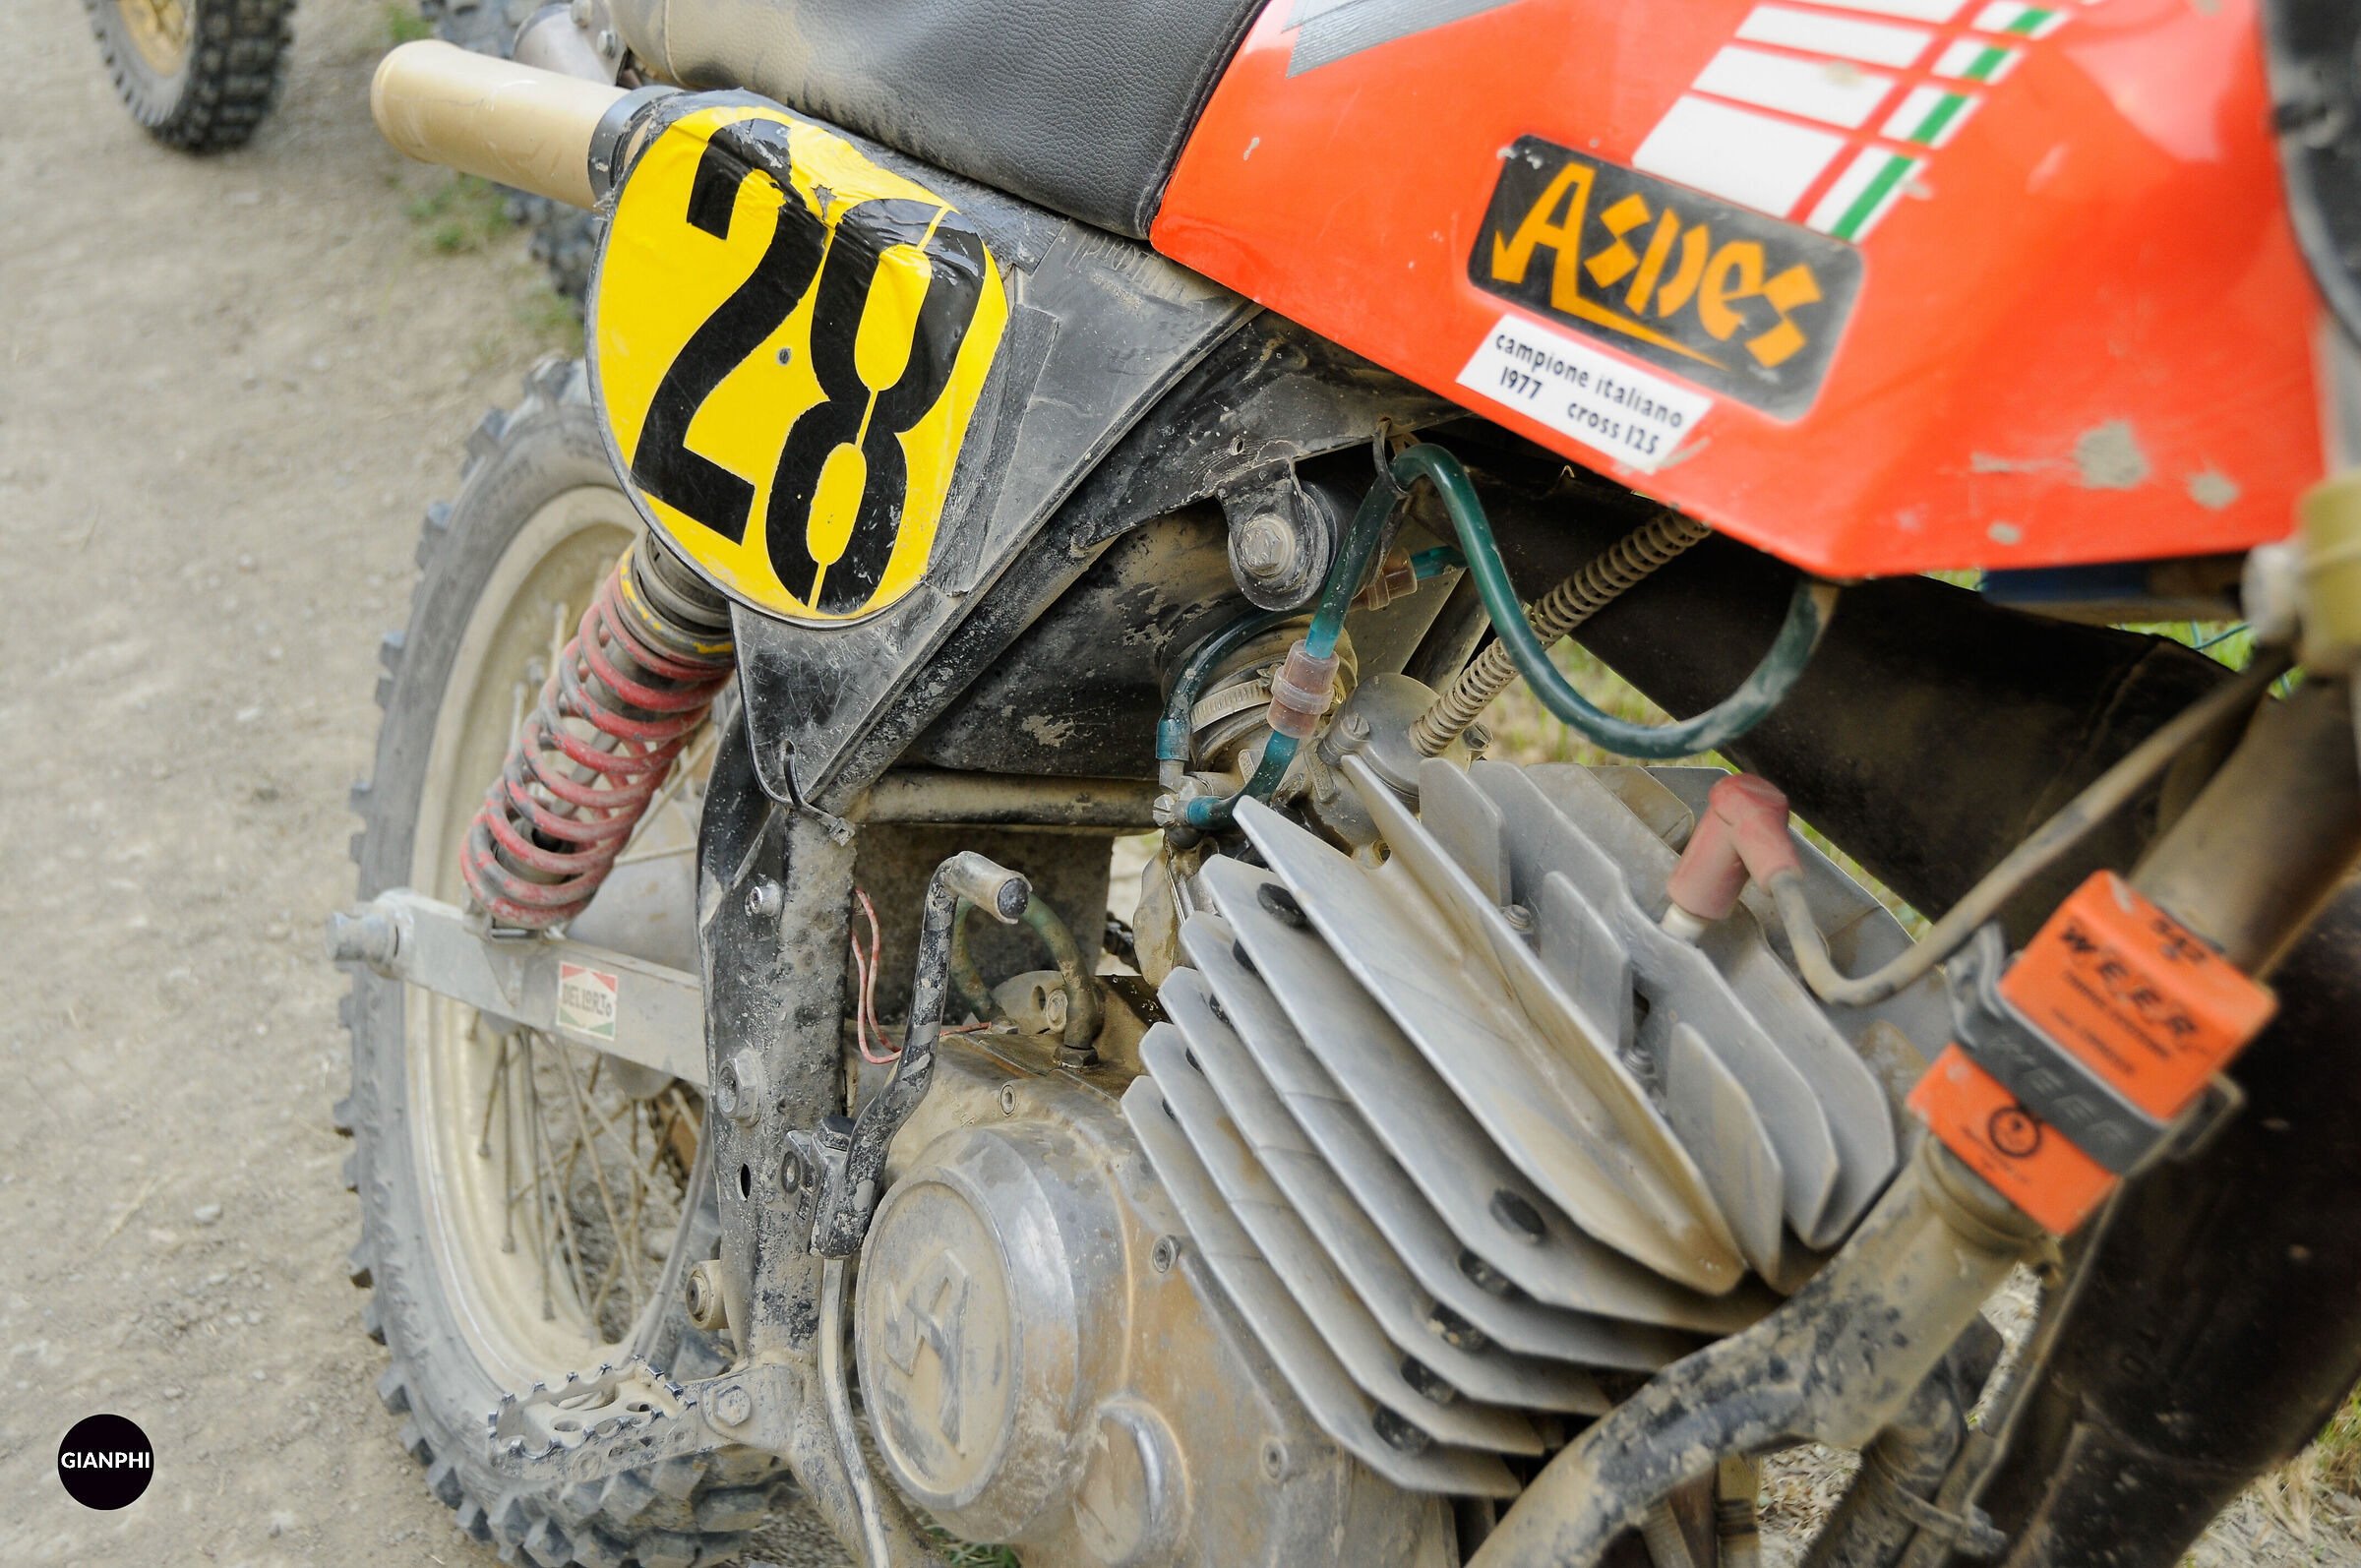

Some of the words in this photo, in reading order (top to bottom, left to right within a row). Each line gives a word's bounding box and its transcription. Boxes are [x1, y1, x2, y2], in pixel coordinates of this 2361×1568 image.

[1490, 161, 1824, 371] Aspes
[630, 118, 986, 614] 28
[1495, 333, 1590, 388] campione
[1596, 376, 1683, 428] italiano
[1500, 366, 1543, 399] 1977
[1567, 402, 1620, 439] cross
[1625, 424, 1660, 454] 125
